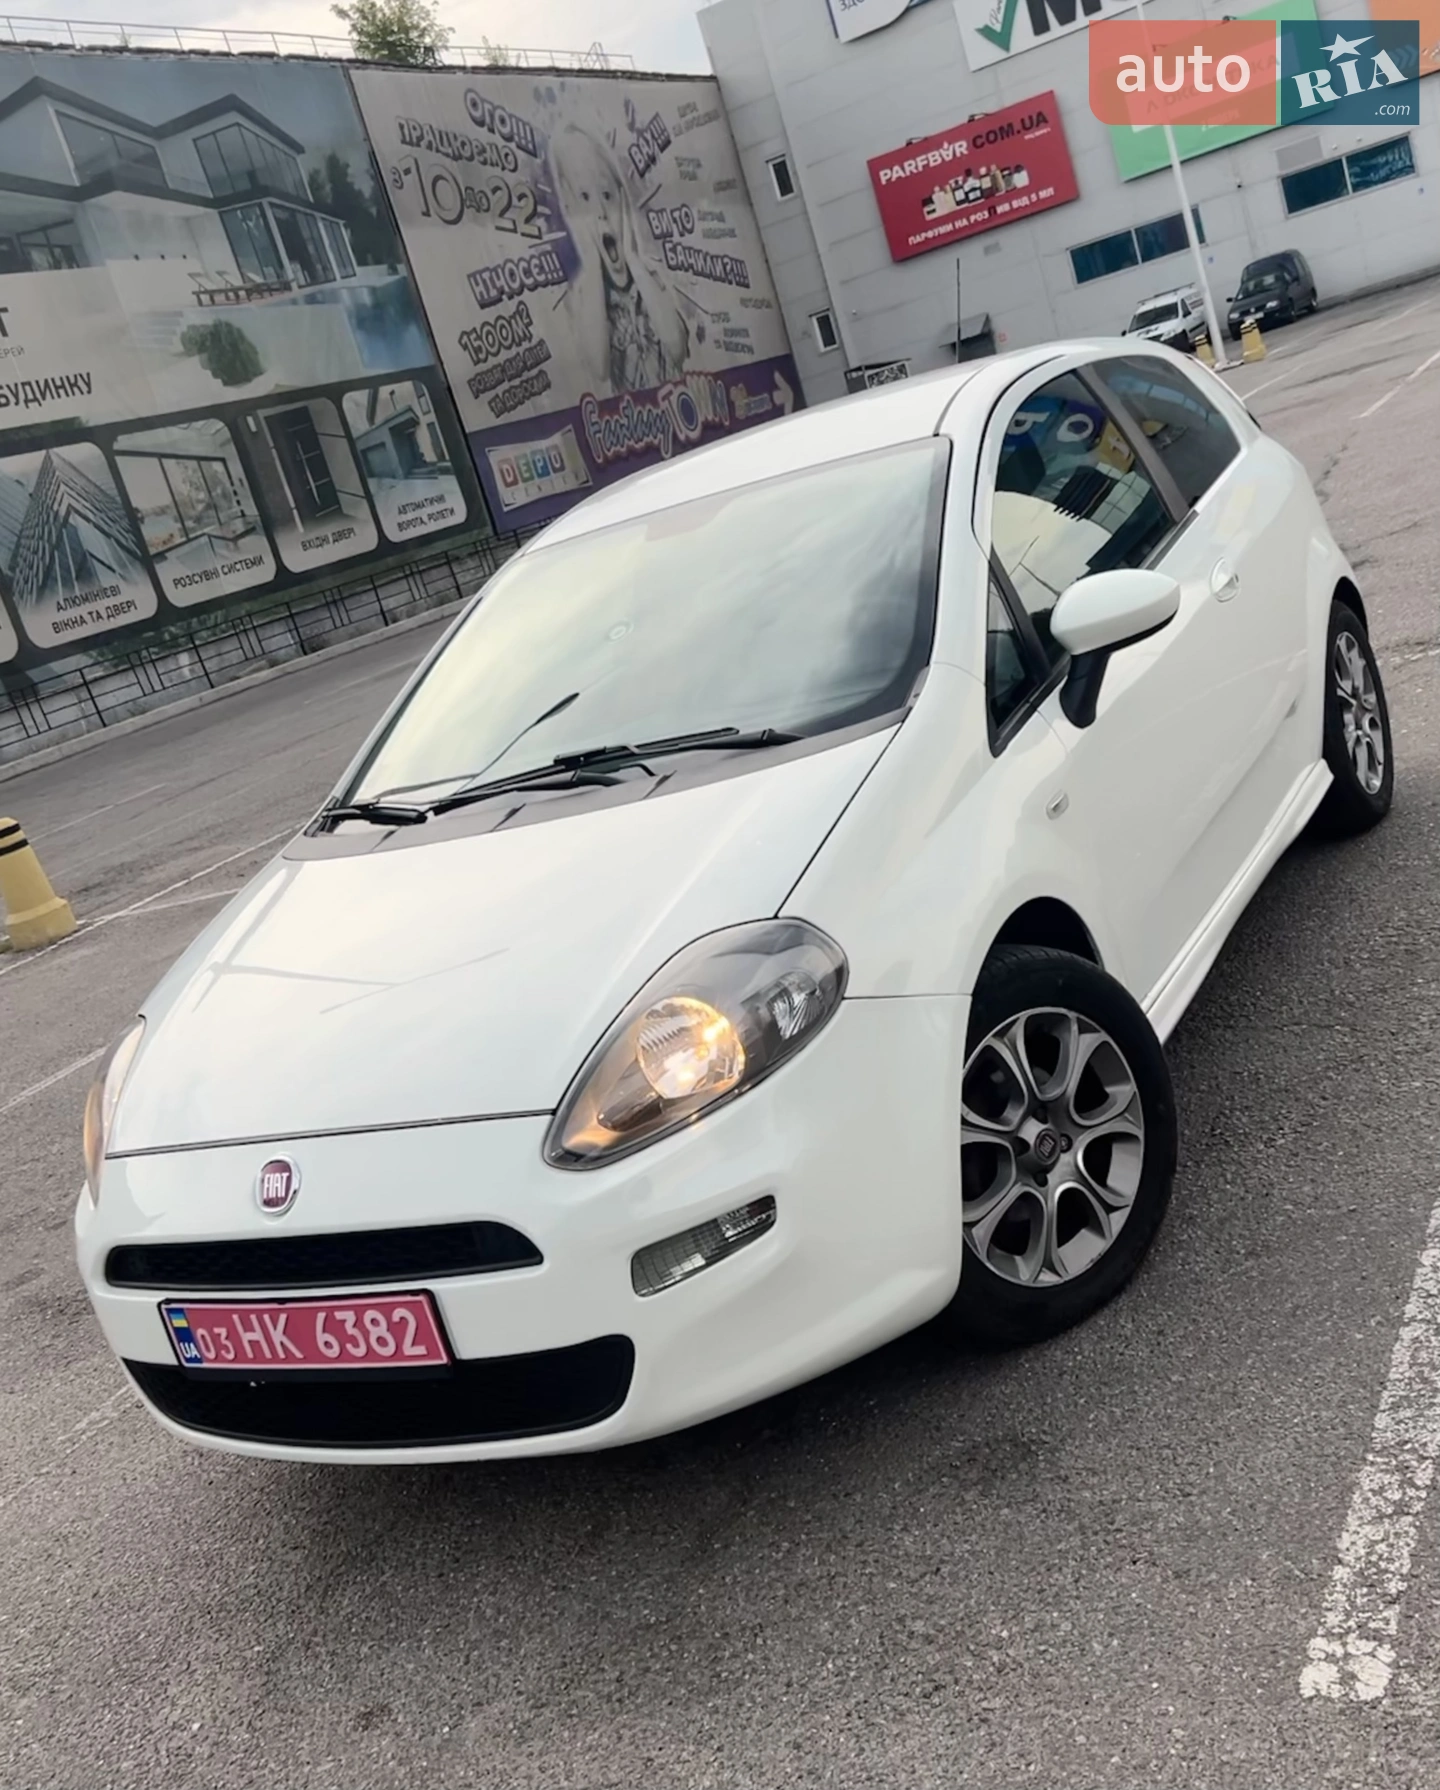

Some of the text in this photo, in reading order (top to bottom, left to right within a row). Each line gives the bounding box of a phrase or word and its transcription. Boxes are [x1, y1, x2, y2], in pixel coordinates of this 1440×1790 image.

[464, 88, 538, 158] ОГО!!!
[972, 111, 1049, 150] COM.UA
[396, 116, 519, 173] ПРАЦЮЄМО
[487, 175, 543, 240] 22
[647, 203, 695, 240] ВИ ТО
[908, 222, 953, 246] ПАРФУМИ
[955, 218, 969, 230] НА
[0, 371, 92, 410] БУДИНКУ
[501, 447, 563, 484] DEPO
[301, 527, 357, 552] ВХІДНІ ДВЕРІ
[173, 555, 266, 590] РОЗСУВНІ СИСТЕМИ
[56, 584, 121, 613] АЛЮМІНІЄВІ
[52, 600, 138, 635] ВІКНА ТА ДВЕРІ
[263, 1172, 290, 1199] FIAT
[179, 1342, 201, 1359] UA
[196, 1307, 428, 1361] 03 HK 6382
